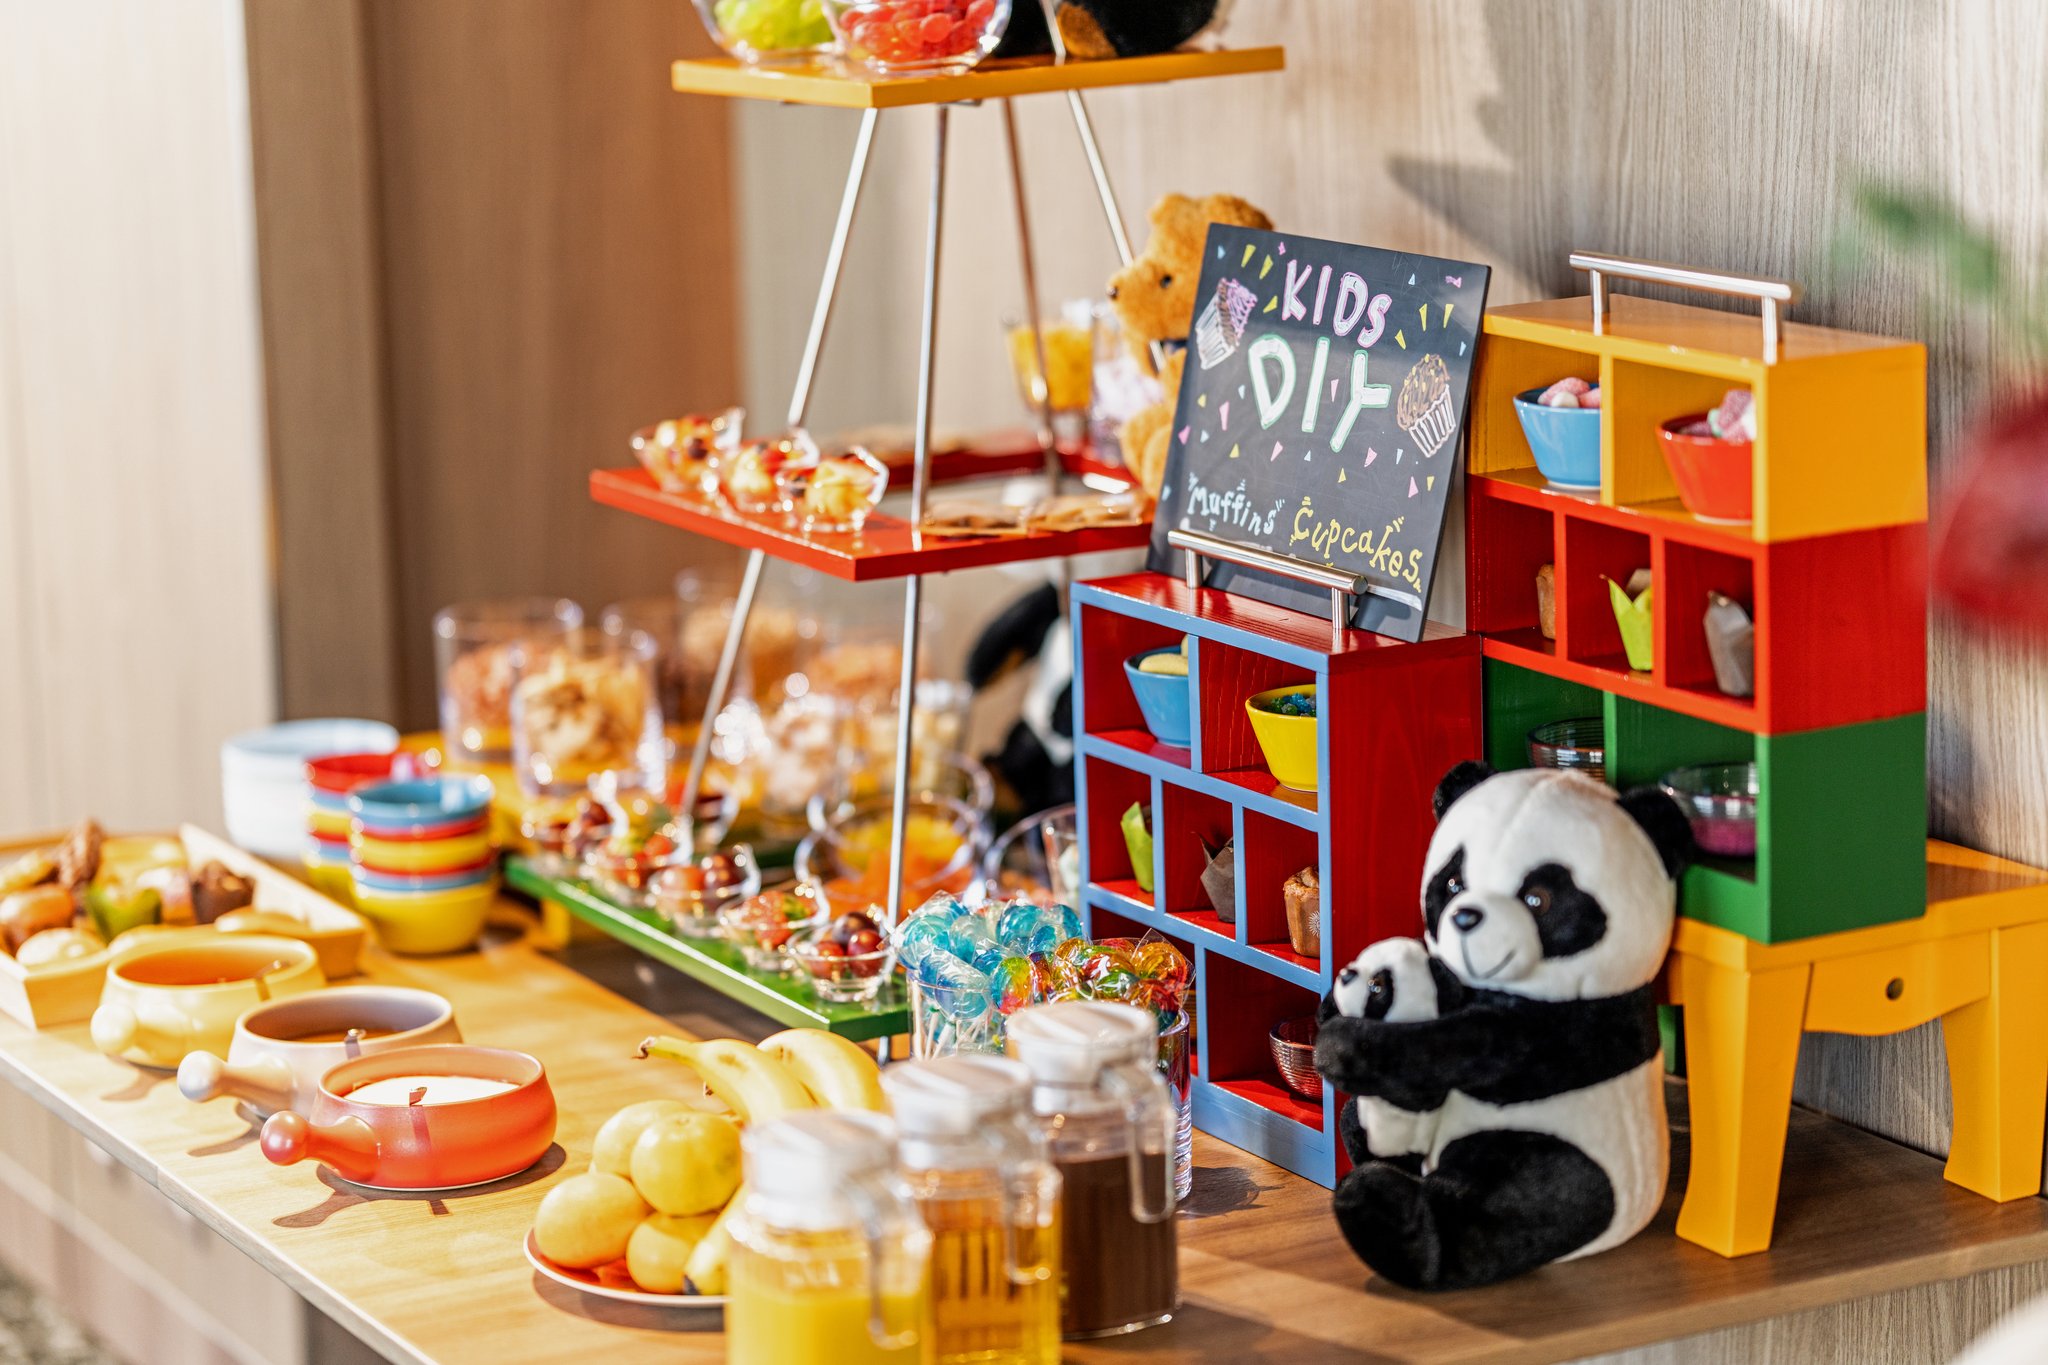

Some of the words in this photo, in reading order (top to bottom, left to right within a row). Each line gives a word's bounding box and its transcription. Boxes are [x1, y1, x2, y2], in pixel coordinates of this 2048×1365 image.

[1248, 334, 1391, 453] DIY
[1187, 486, 1276, 536] Muffins
[1293, 506, 1423, 584] Cupcakes
